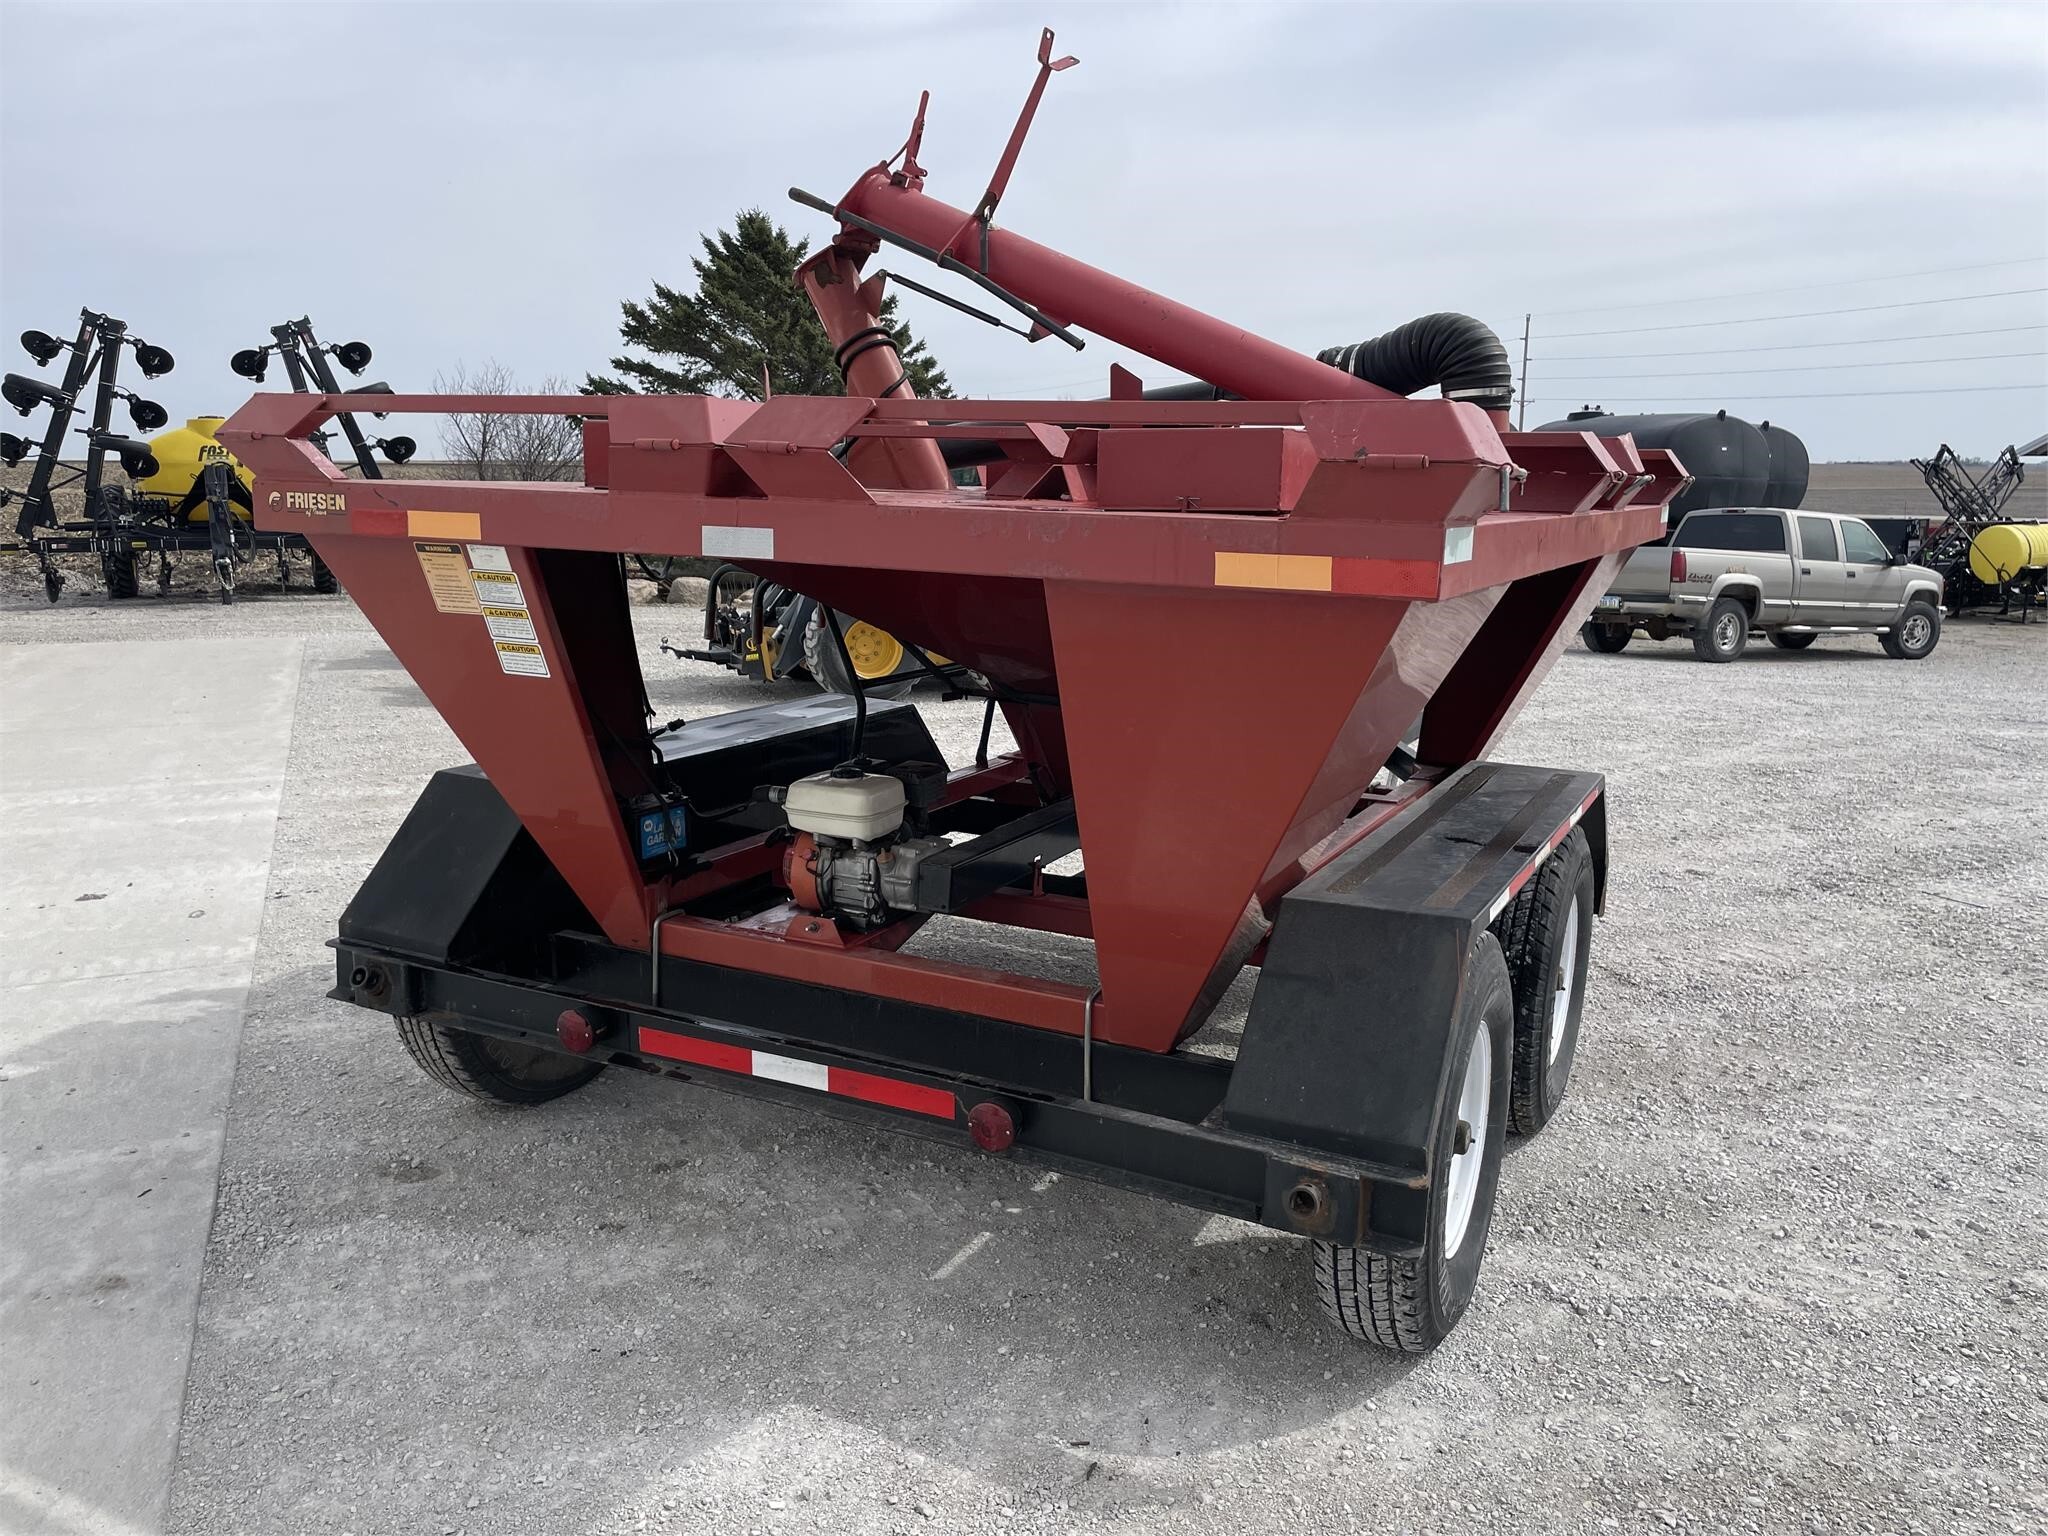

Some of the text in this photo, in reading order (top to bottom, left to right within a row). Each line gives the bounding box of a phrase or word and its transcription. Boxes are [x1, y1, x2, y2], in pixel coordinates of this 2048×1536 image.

[286, 492, 346, 511] FRIESEN
[424, 545, 452, 553] WARNING
[483, 574, 512, 582] CAUTION
[494, 610, 524, 618] CAUTION
[507, 645, 536, 653] CAUTION
